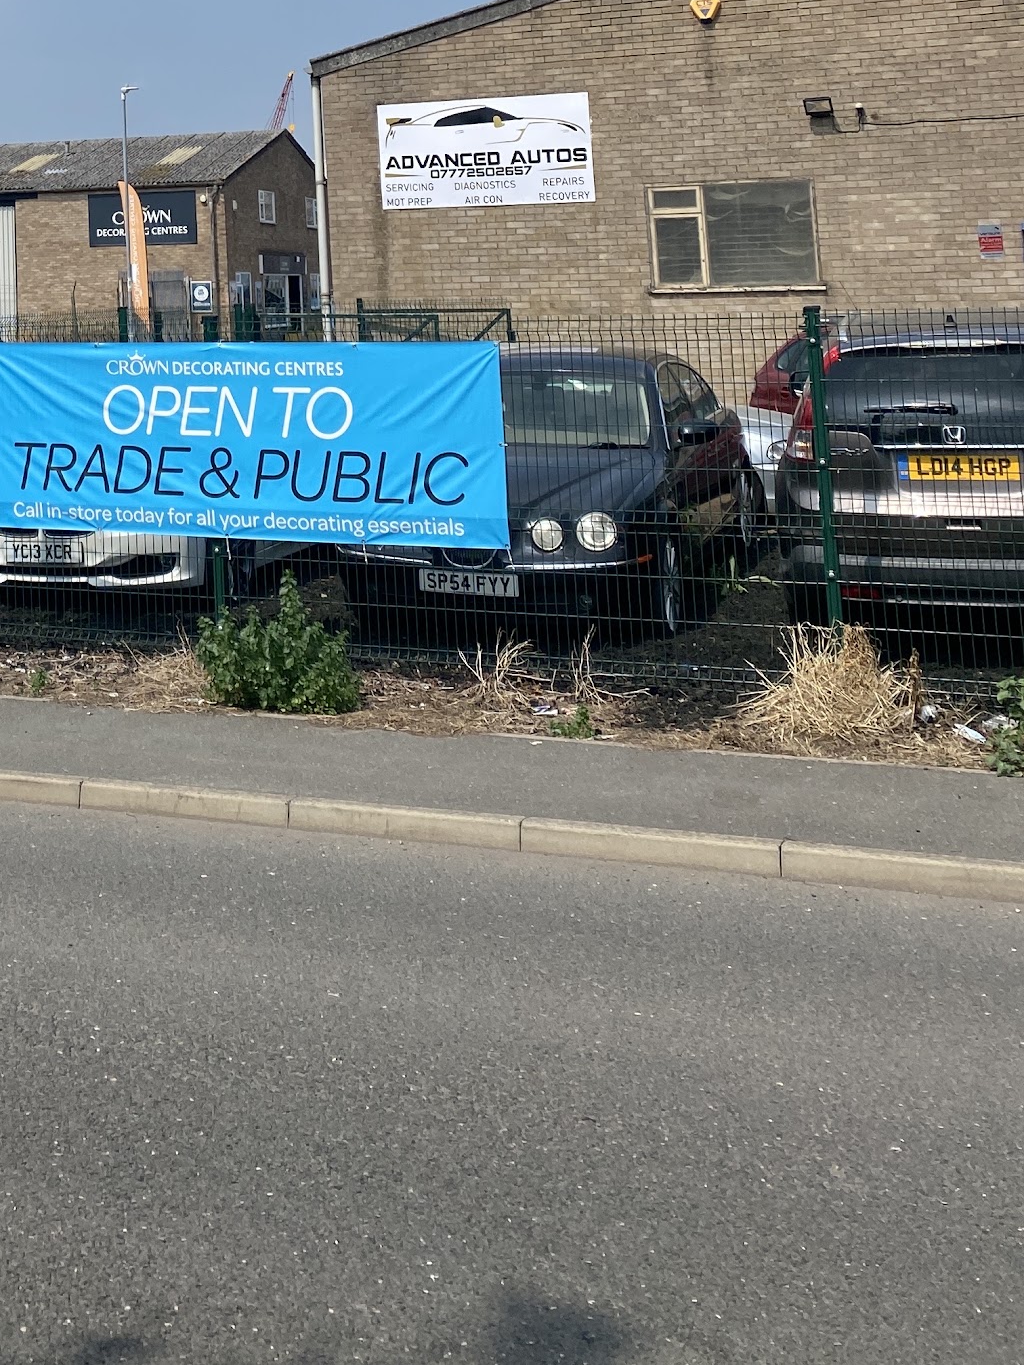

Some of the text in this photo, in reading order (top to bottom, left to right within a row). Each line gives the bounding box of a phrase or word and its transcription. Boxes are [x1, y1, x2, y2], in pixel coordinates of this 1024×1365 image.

[386, 147, 588, 170] ADVANCED AUTOS
[430, 166, 533, 179] 07772502657
[385, 177, 585, 193] SERVICING DIAGNOSTICS REPAIRS
[386, 191, 591, 207] MOT PREP AIR CON RECOVERY
[151, 225, 188, 236] CENTRES
[106, 359, 344, 377] CROWN DECORATING CENTRES
[103, 384, 354, 440] OPEN TO
[14, 442, 469, 506] TRADE & PUBLIC
[916, 457, 1012, 476] LD14 HGP
[13, 501, 465, 538] Call in-store today for all your decorating essentials
[12, 543, 72, 560] YC13 XCR
[426, 572, 511, 594] SP54 FYY
